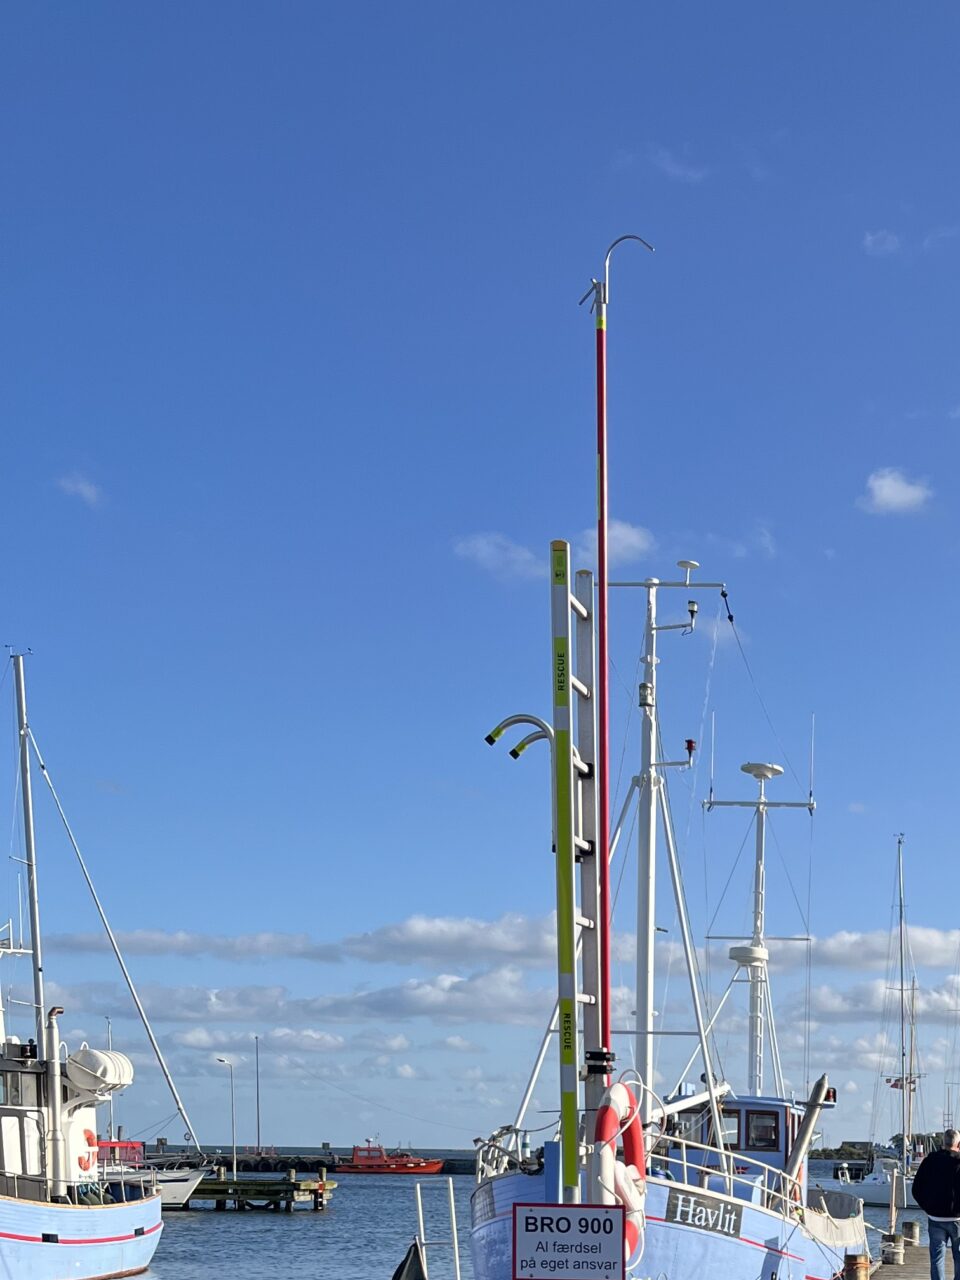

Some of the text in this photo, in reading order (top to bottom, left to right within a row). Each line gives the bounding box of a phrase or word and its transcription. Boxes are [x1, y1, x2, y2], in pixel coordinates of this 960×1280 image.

[557, 651, 565, 691] RESCUE
[563, 1013, 572, 1050] RESCUE
[525, 1216, 614, 1235] BRO 900
[673, 1193, 737, 1234] Havlit
[535, 1240, 602, 1254] Al færdsel
[520, 1256, 618, 1272] på eget ansvar
